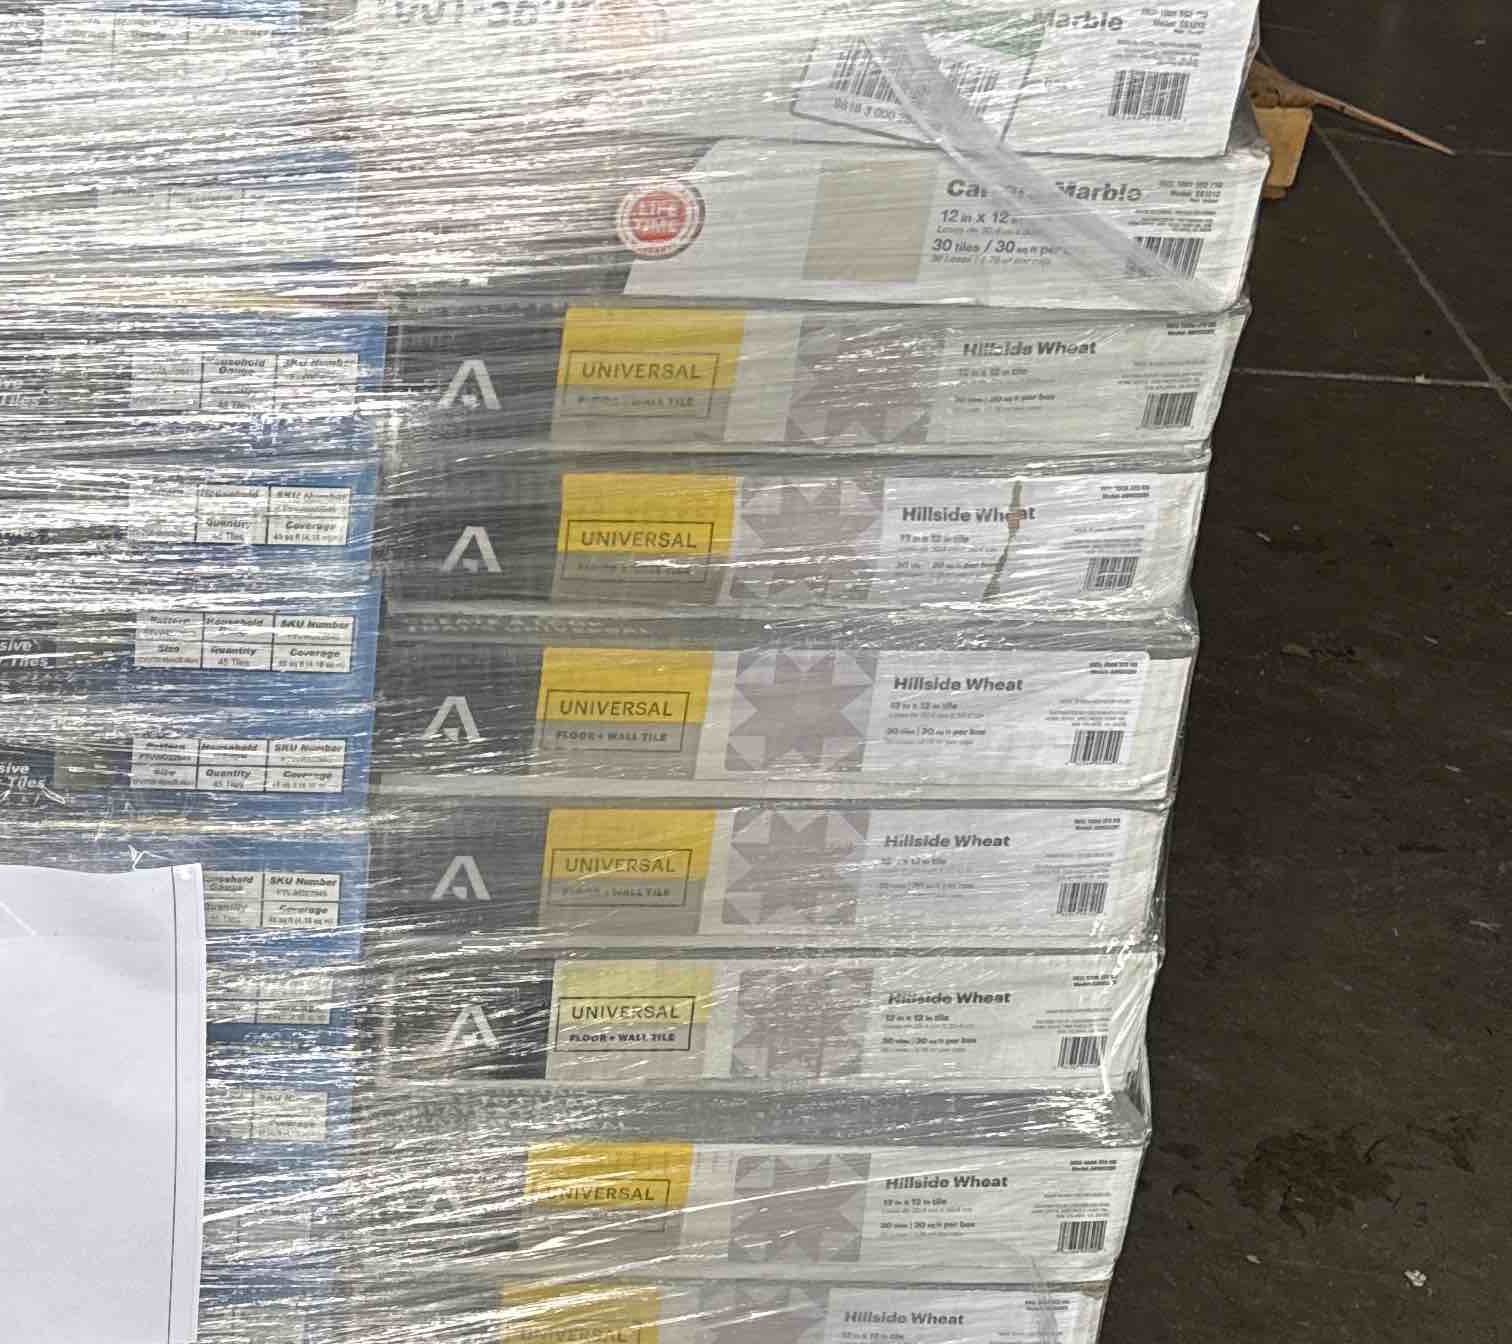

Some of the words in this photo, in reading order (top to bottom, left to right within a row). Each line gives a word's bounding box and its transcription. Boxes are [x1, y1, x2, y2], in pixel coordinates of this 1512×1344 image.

[940, 209, 959, 224] 12
[975, 212, 986, 223] x
[991, 209, 1010, 224] 12
[931, 238, 953, 253] 30
[994, 240, 1016, 254] 30
[962, 341, 1034, 358] Hillside
[1037, 340, 1097, 357] Wheat
[582, 362, 703, 380] UNIVERSAL
[901, 506, 973, 523] Hillside
[581, 530, 697, 549] UNIVERSAL
[289, 647, 341, 659] Coverage
[893, 676, 961, 691] Hillside
[965, 677, 1024, 692] Wheat
[559, 700, 674, 717] UNIVERSAL
[555, 730, 595, 742] FLOOR
[607, 731, 640, 743] WALL
[641, 732, 669, 743] TILE
[205, 768, 252, 780] Quantity
[4, 775, 47, 790] Tiles
[884, 834, 951, 848] Hillside
[954, 834, 1011, 848] Wheat
[565, 857, 677, 874] UNIVERSAL
[269, 875, 291, 886] SKU
[294, 876, 337, 888] Number
[956, 991, 1011, 1005] Wheat
[570, 1004, 680, 1021] UNIVERSAL
[568, 1033, 607, 1043] FLOOR
[617, 1033, 649, 1043] WALL
[650, 1033, 676, 1043] TILE
[884, 1176, 950, 1190] Hillside
[953, 1175, 1009, 1189] Wheat
[843, 1311, 907, 1325] Hillside
[911, 1311, 965, 1326] Wheat
